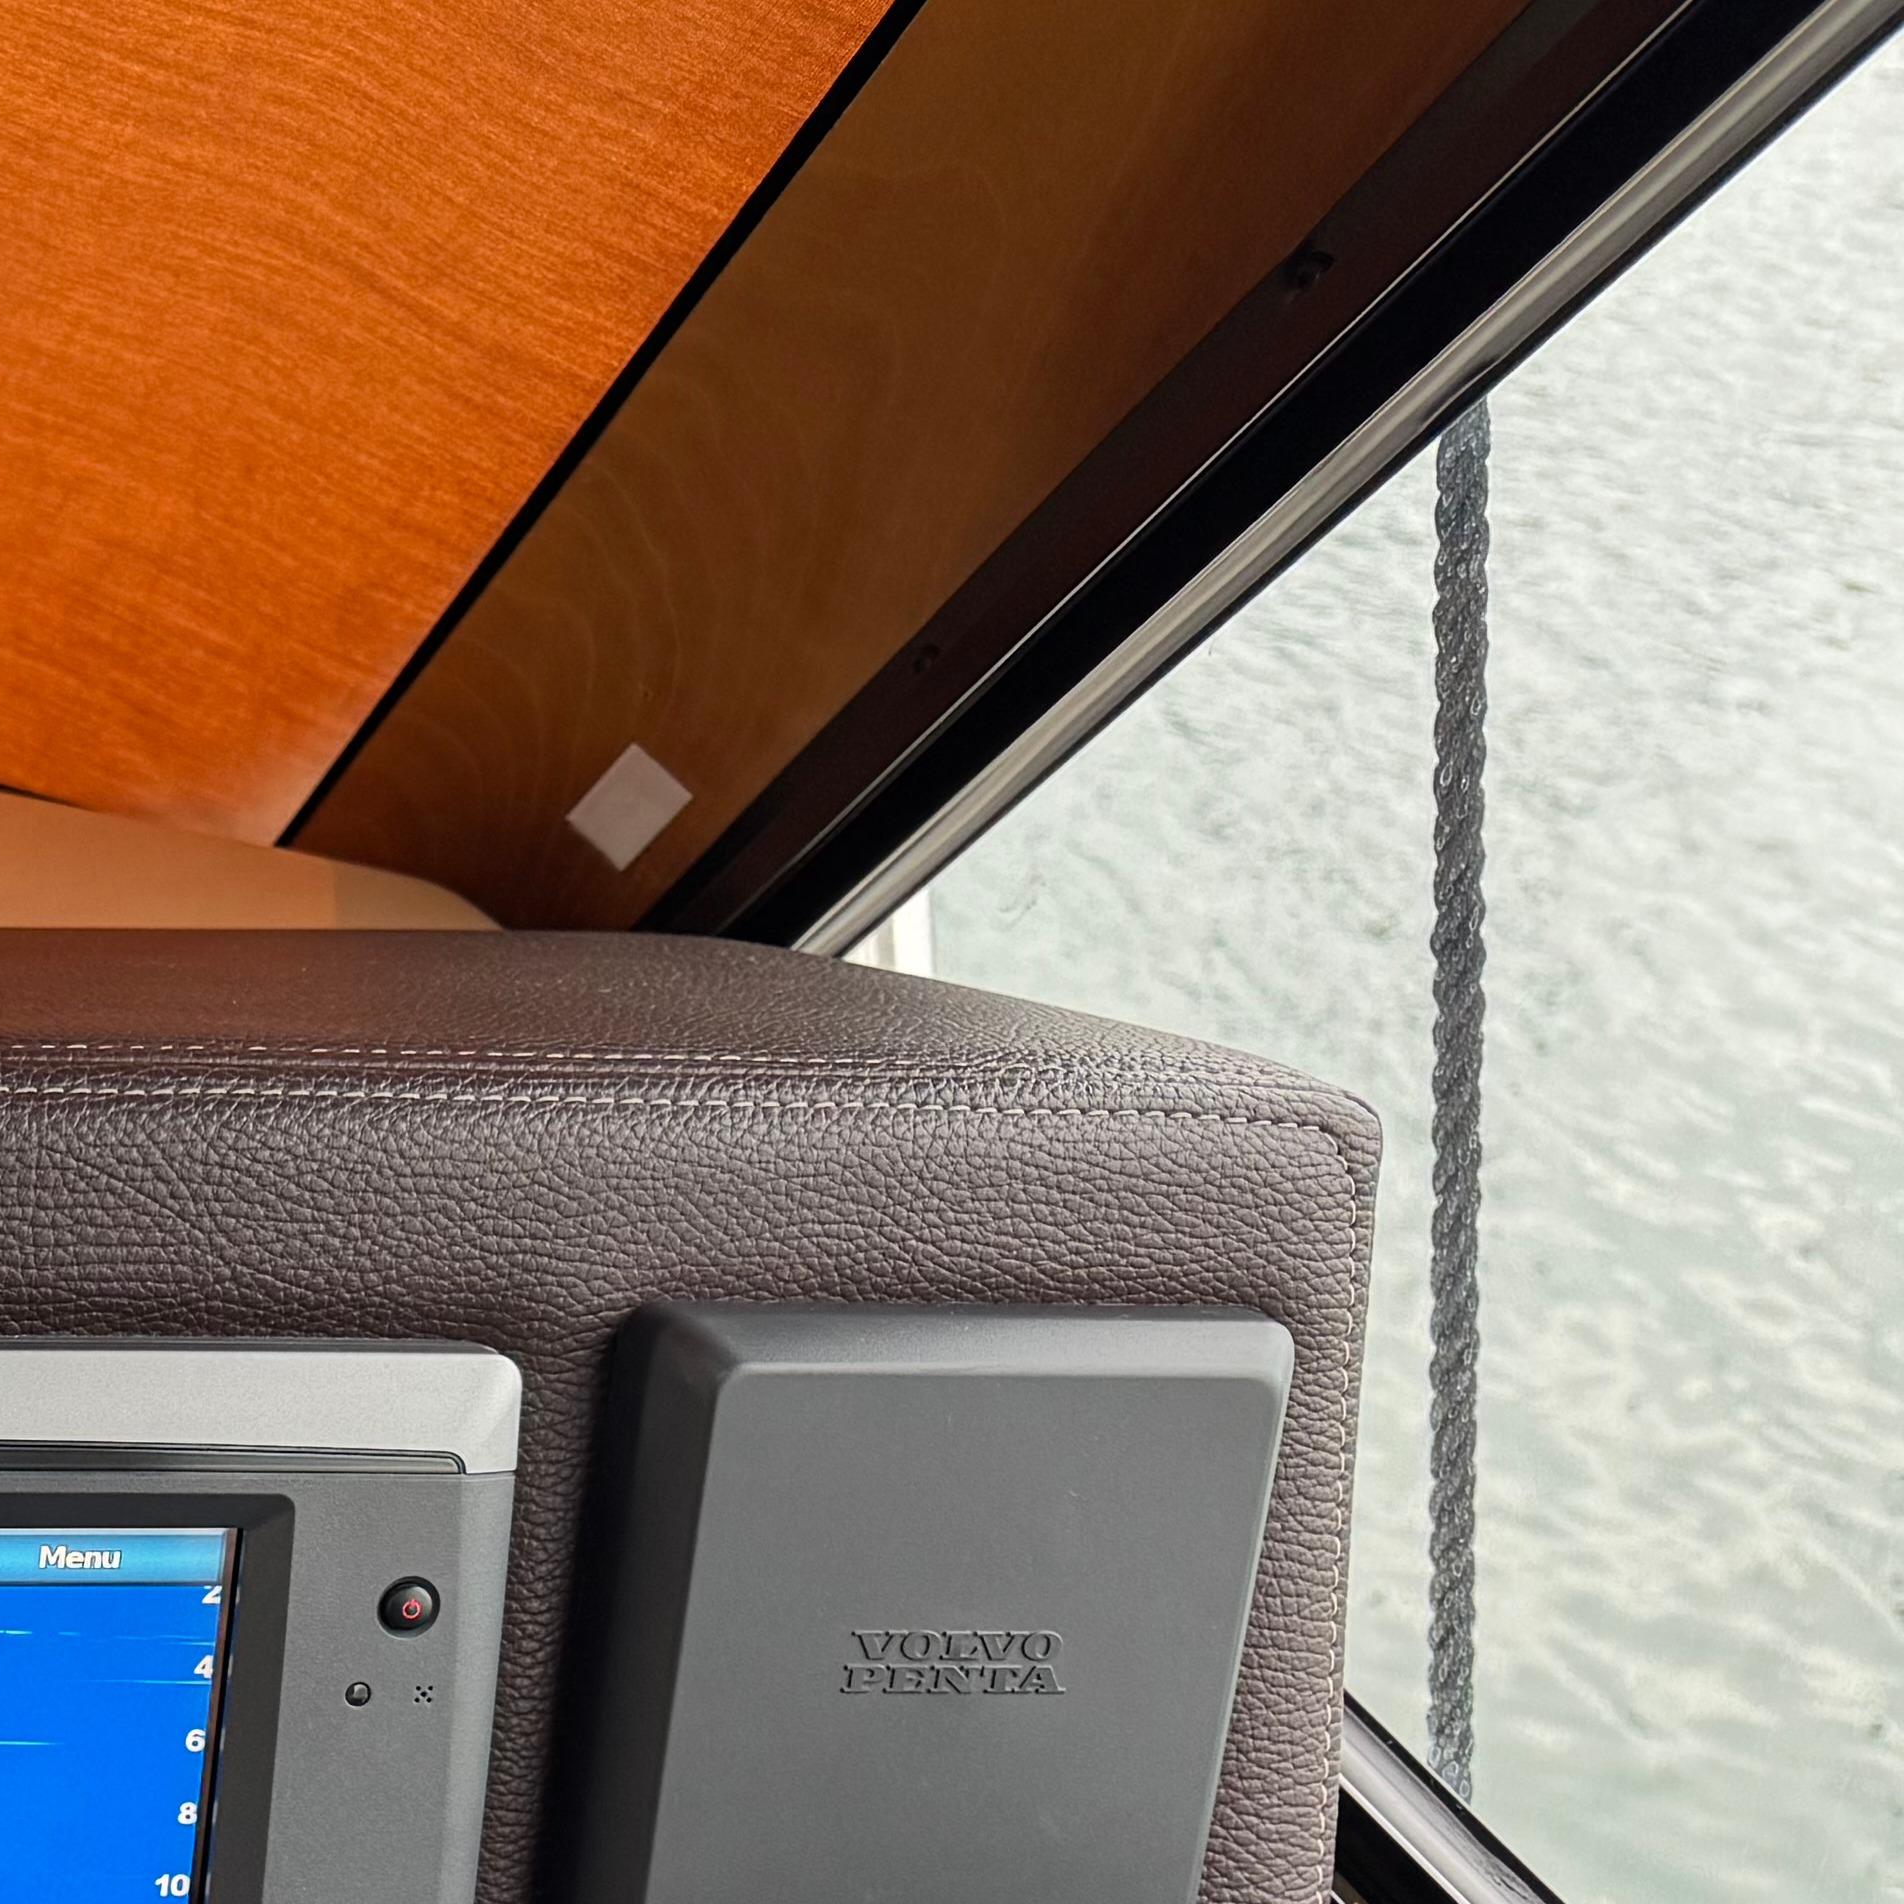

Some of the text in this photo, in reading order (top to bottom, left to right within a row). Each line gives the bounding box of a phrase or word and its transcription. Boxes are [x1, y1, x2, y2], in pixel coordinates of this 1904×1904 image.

[38, 1545, 122, 1570] Menu
[850, 1630, 1065, 1661] VOLVO
[193, 1655, 214, 1680] 4
[840, 1665, 1067, 1694] PENTA
[185, 1729, 207, 1753] 6
[177, 1801, 198, 1825] 8
[155, 1873, 190, 1898] 10
